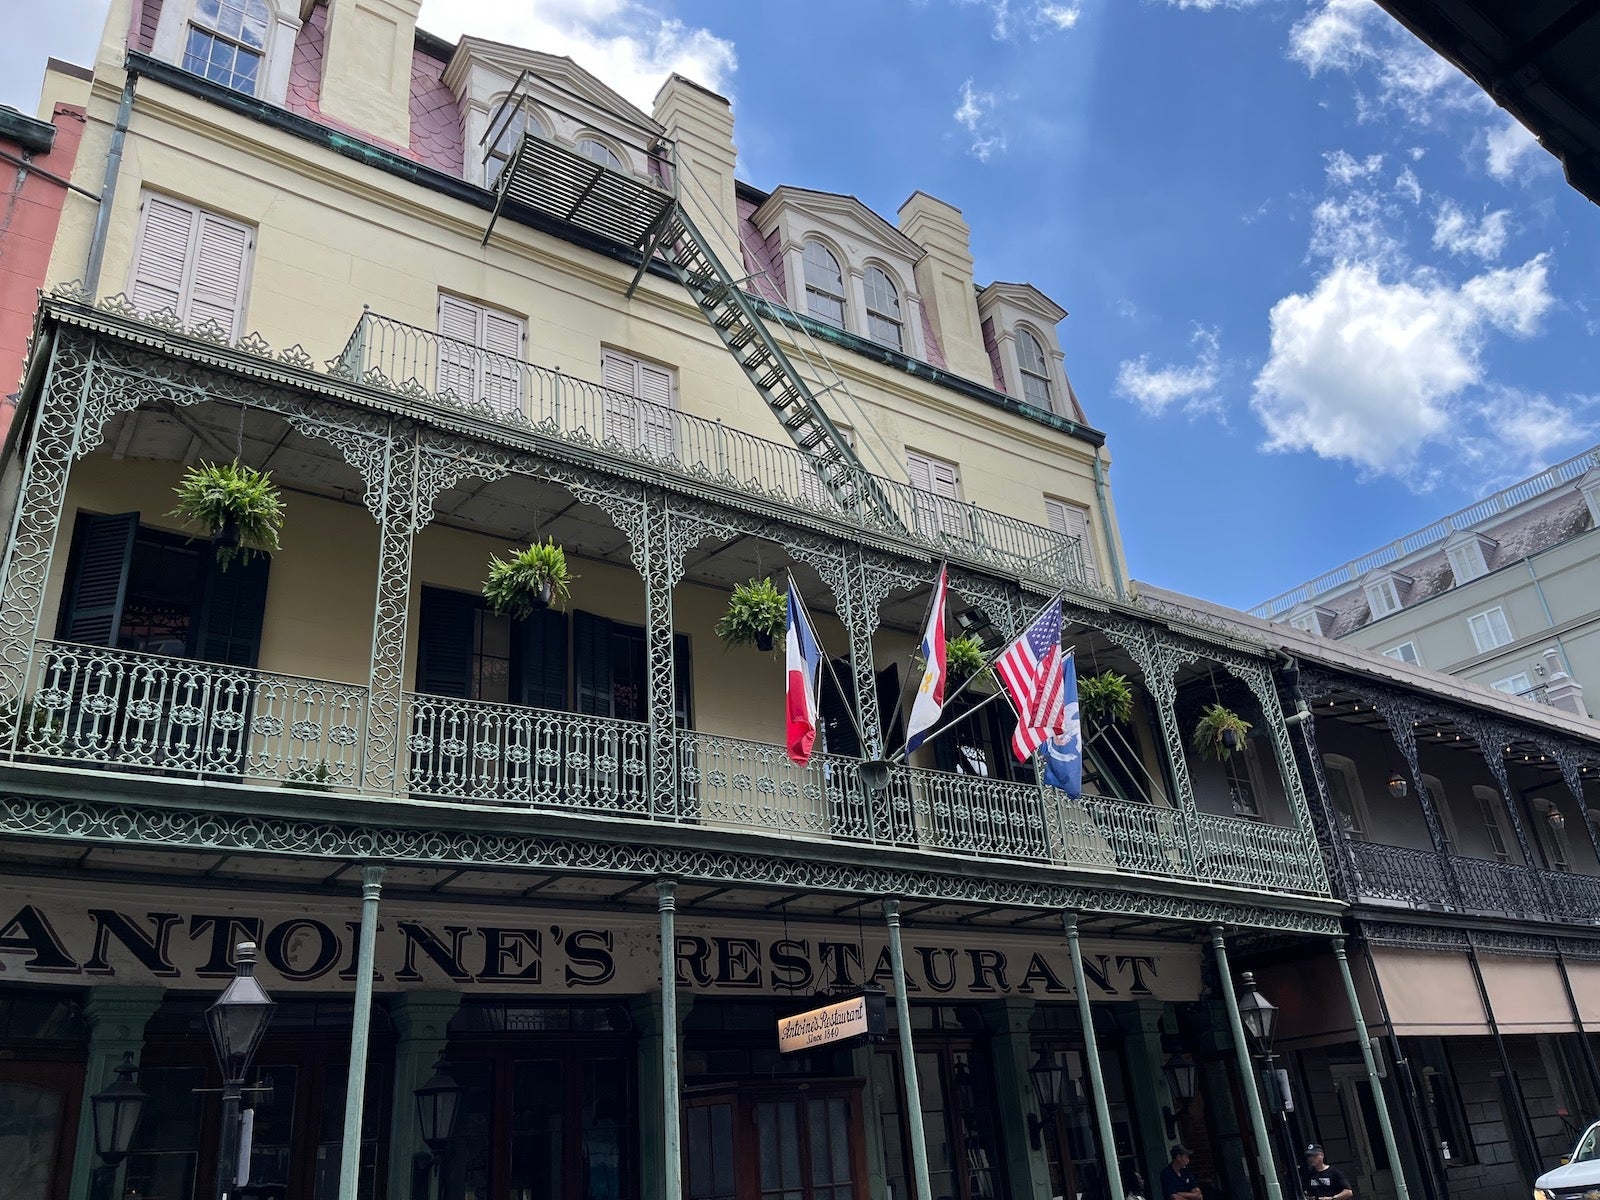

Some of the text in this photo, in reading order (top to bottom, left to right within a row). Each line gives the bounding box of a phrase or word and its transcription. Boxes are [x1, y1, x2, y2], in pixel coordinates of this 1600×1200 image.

[657, 934, 1159, 995] RESTAURANT
[781, 1002, 864, 1040] Antoine's Restaurant
[806, 1026, 839, 1045] Since 1840
